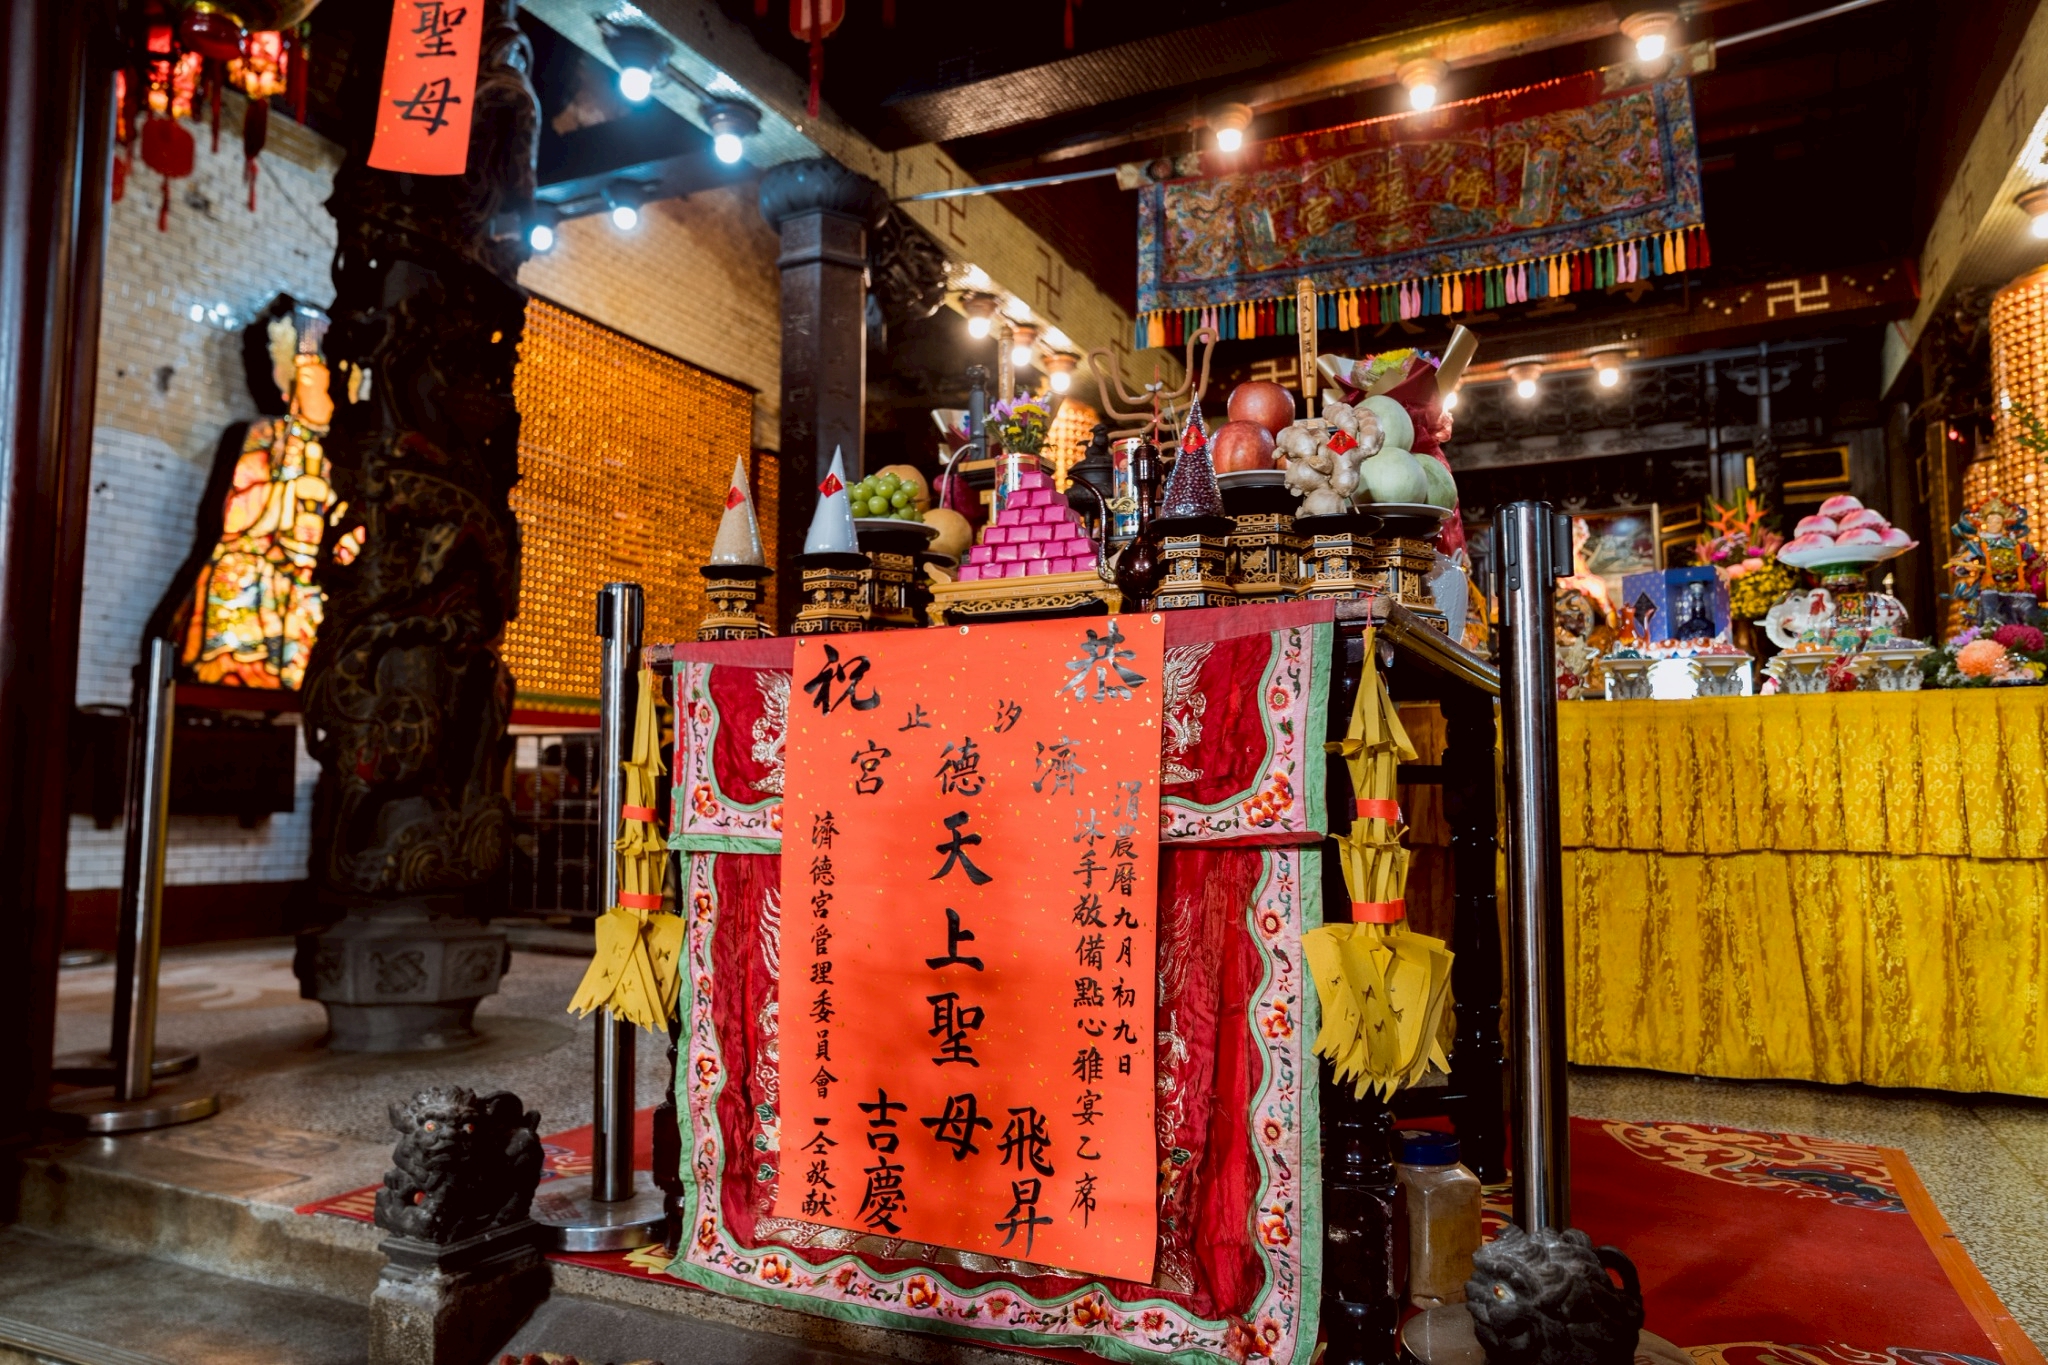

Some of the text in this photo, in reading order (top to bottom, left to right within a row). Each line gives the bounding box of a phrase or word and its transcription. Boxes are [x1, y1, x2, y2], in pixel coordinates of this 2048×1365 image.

[392, 1, 467, 136] 聖母
[920, 810, 994, 1162] 天上聖母
[855, 1088, 907, 1235] 吉慶
